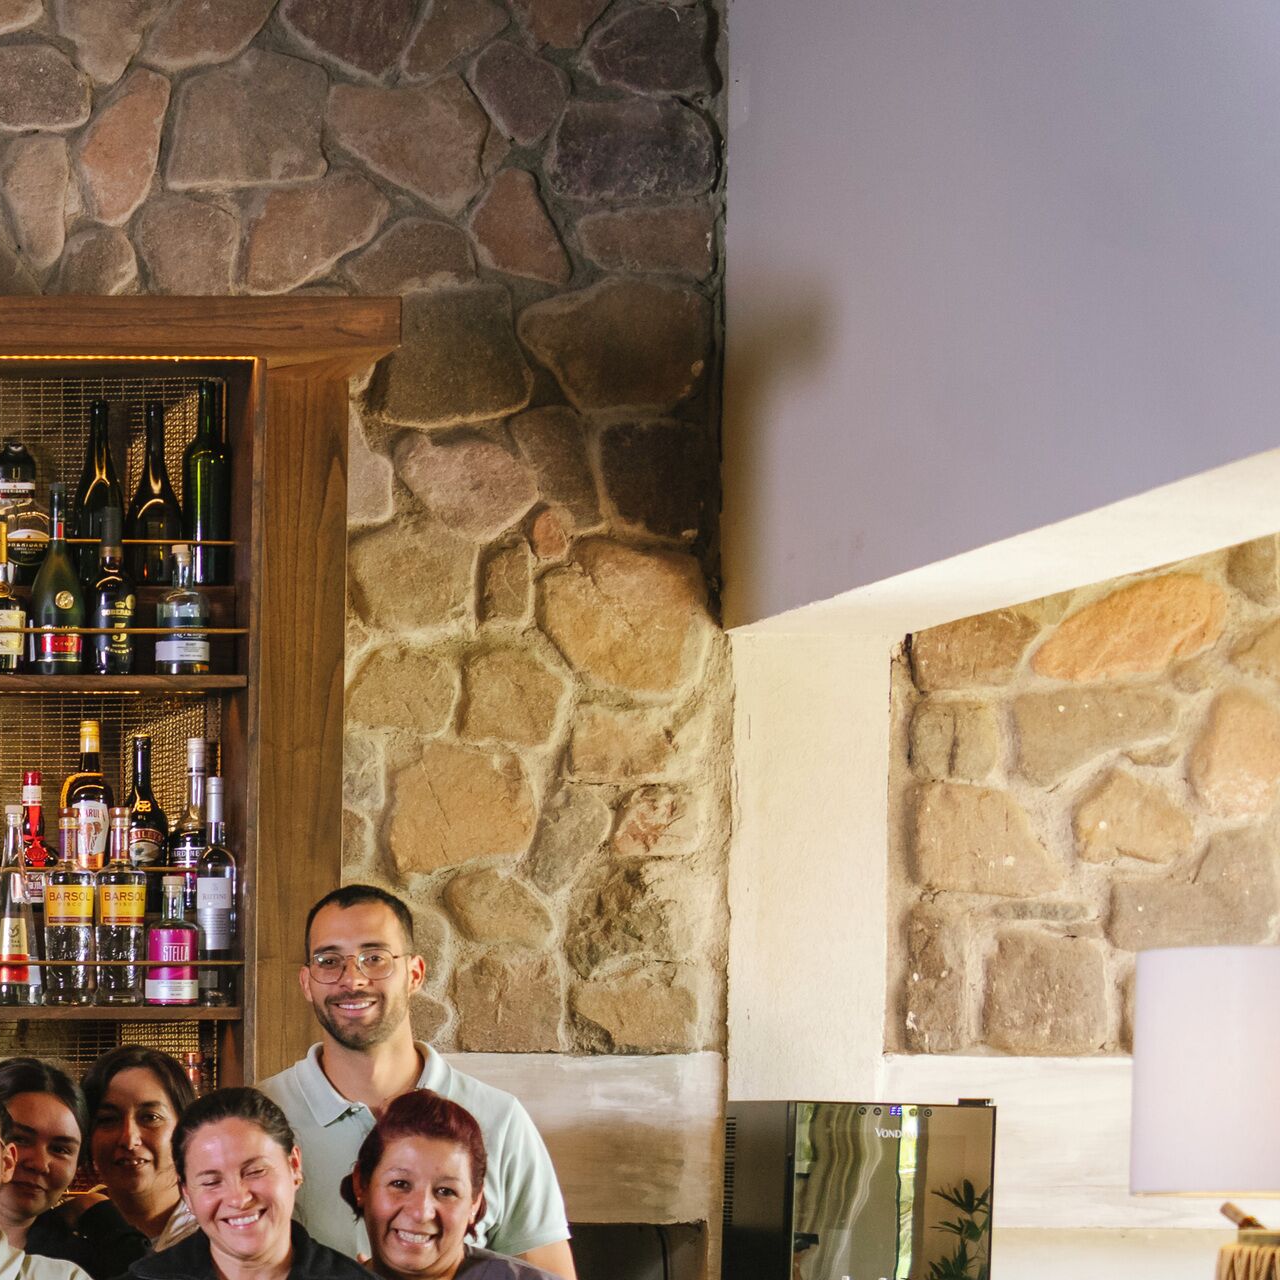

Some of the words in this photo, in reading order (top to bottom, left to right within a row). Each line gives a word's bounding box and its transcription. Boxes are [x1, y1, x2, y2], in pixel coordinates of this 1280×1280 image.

[129, 830, 163, 844] AILEYS
[49, 891, 91, 902] BARSOL
[104, 891, 145, 903] BARSOL
[162, 945, 190, 962] STELLA
